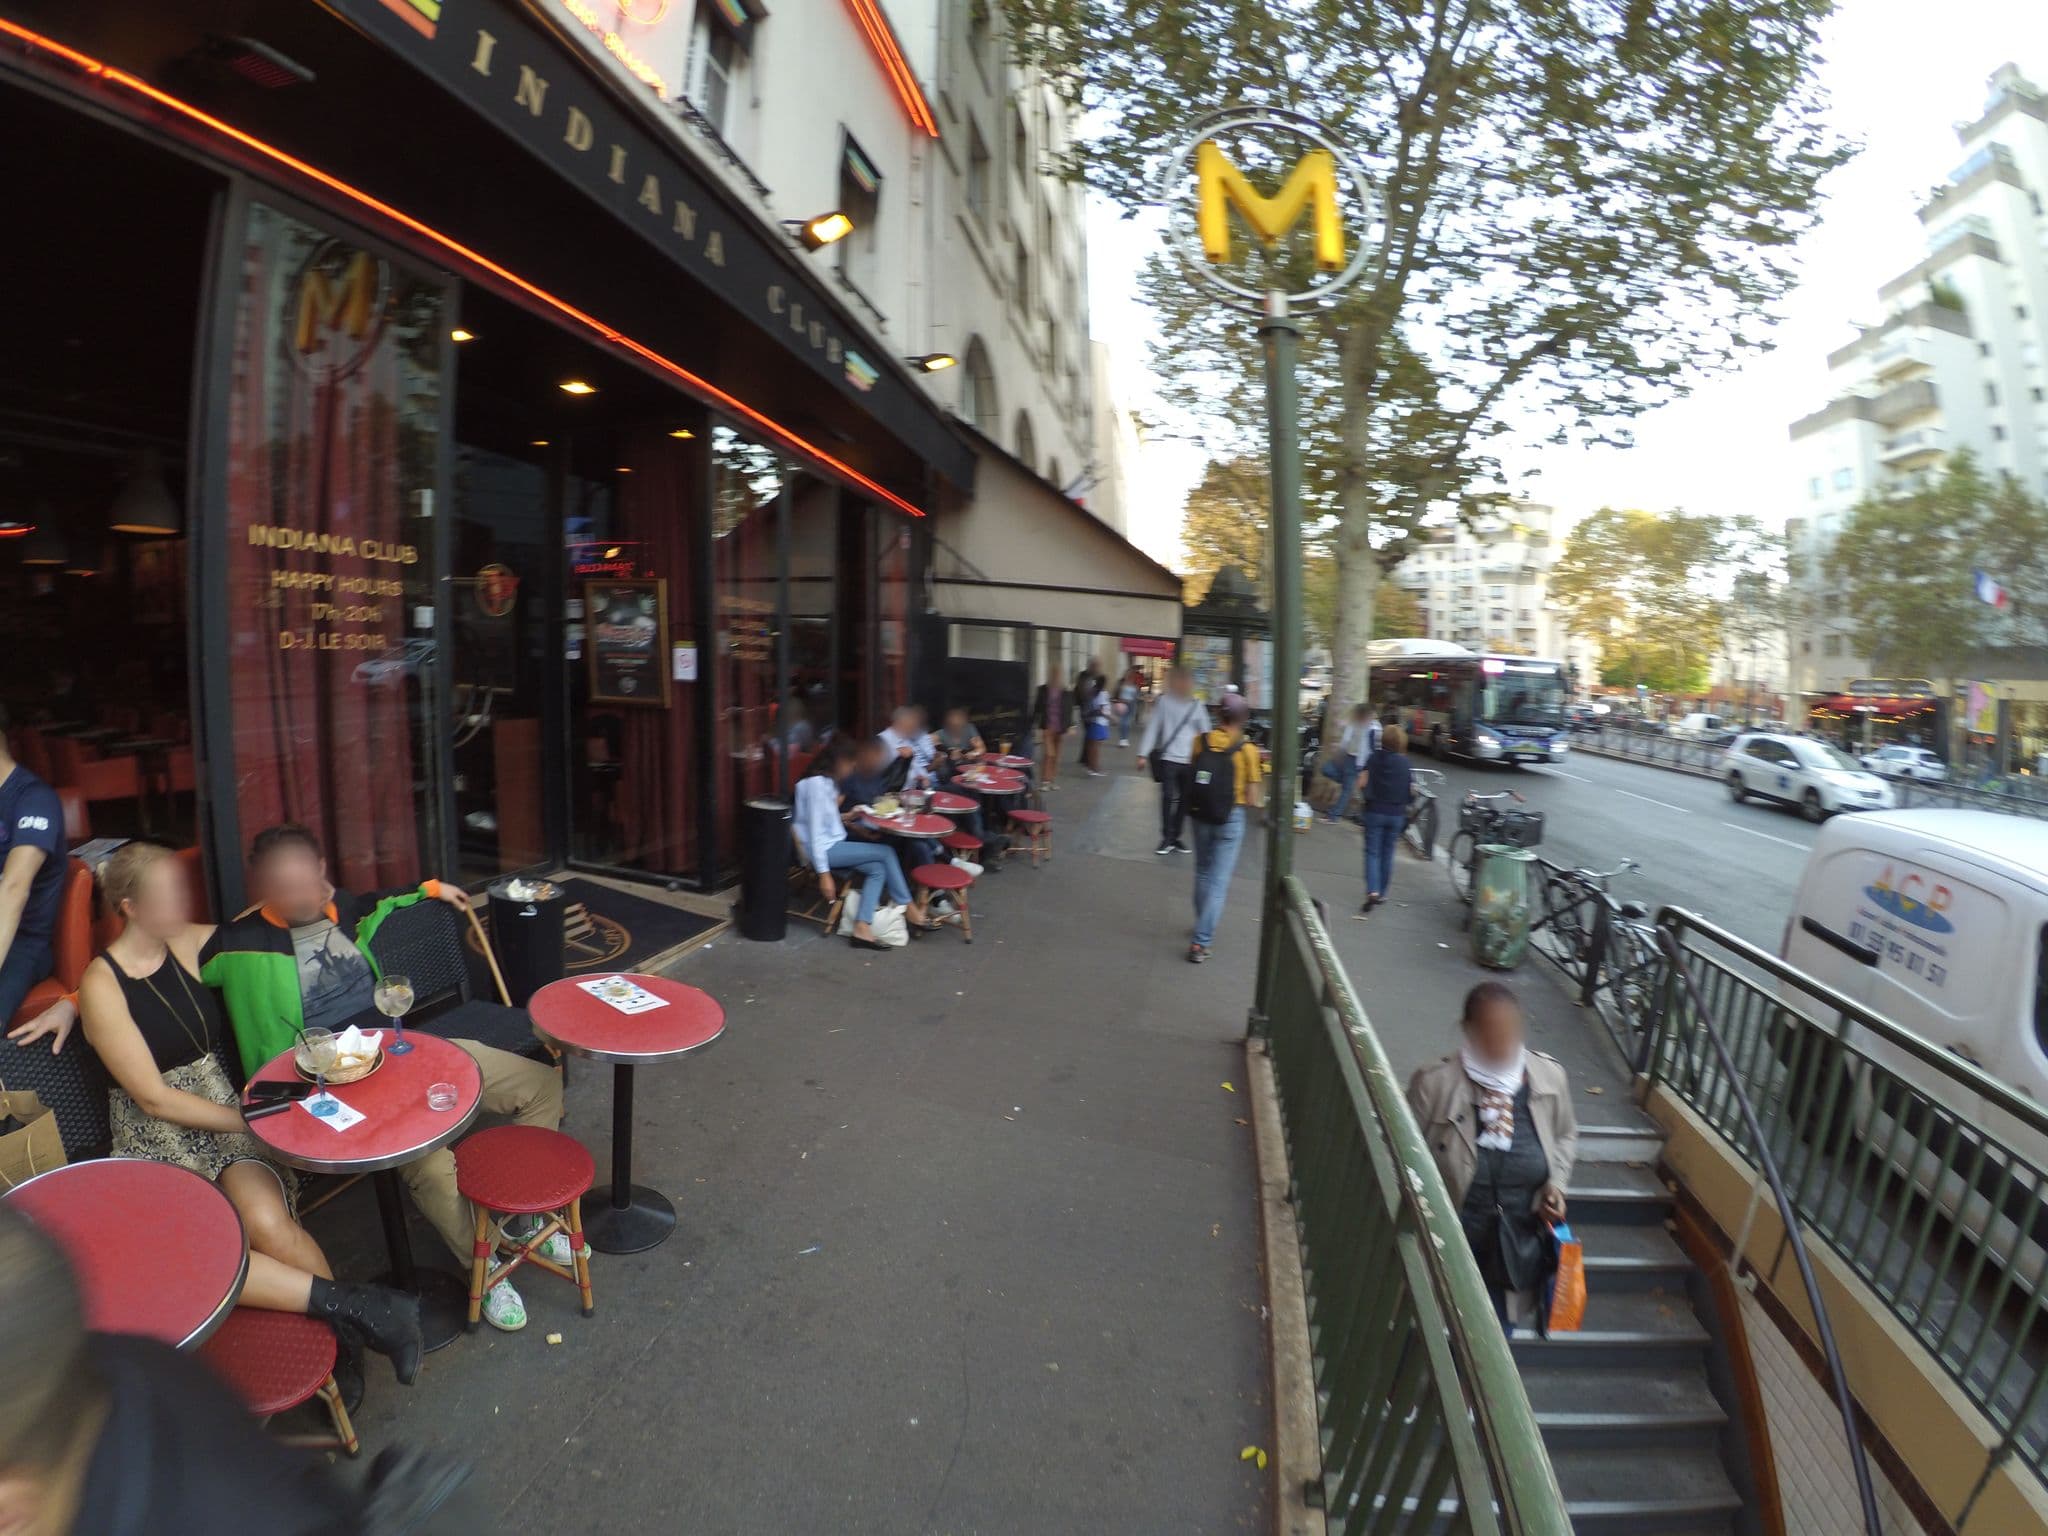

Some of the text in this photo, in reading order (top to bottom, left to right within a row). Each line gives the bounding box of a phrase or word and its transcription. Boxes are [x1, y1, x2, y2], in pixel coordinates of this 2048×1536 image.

[471, 29, 727, 268] INDIANA
[767, 285, 843, 364] CLUB
[1196, 139, 1345, 272] M
[248, 523, 418, 564] INDIANA CLUB
[271, 570, 403, 597] HAPPY HOURS
